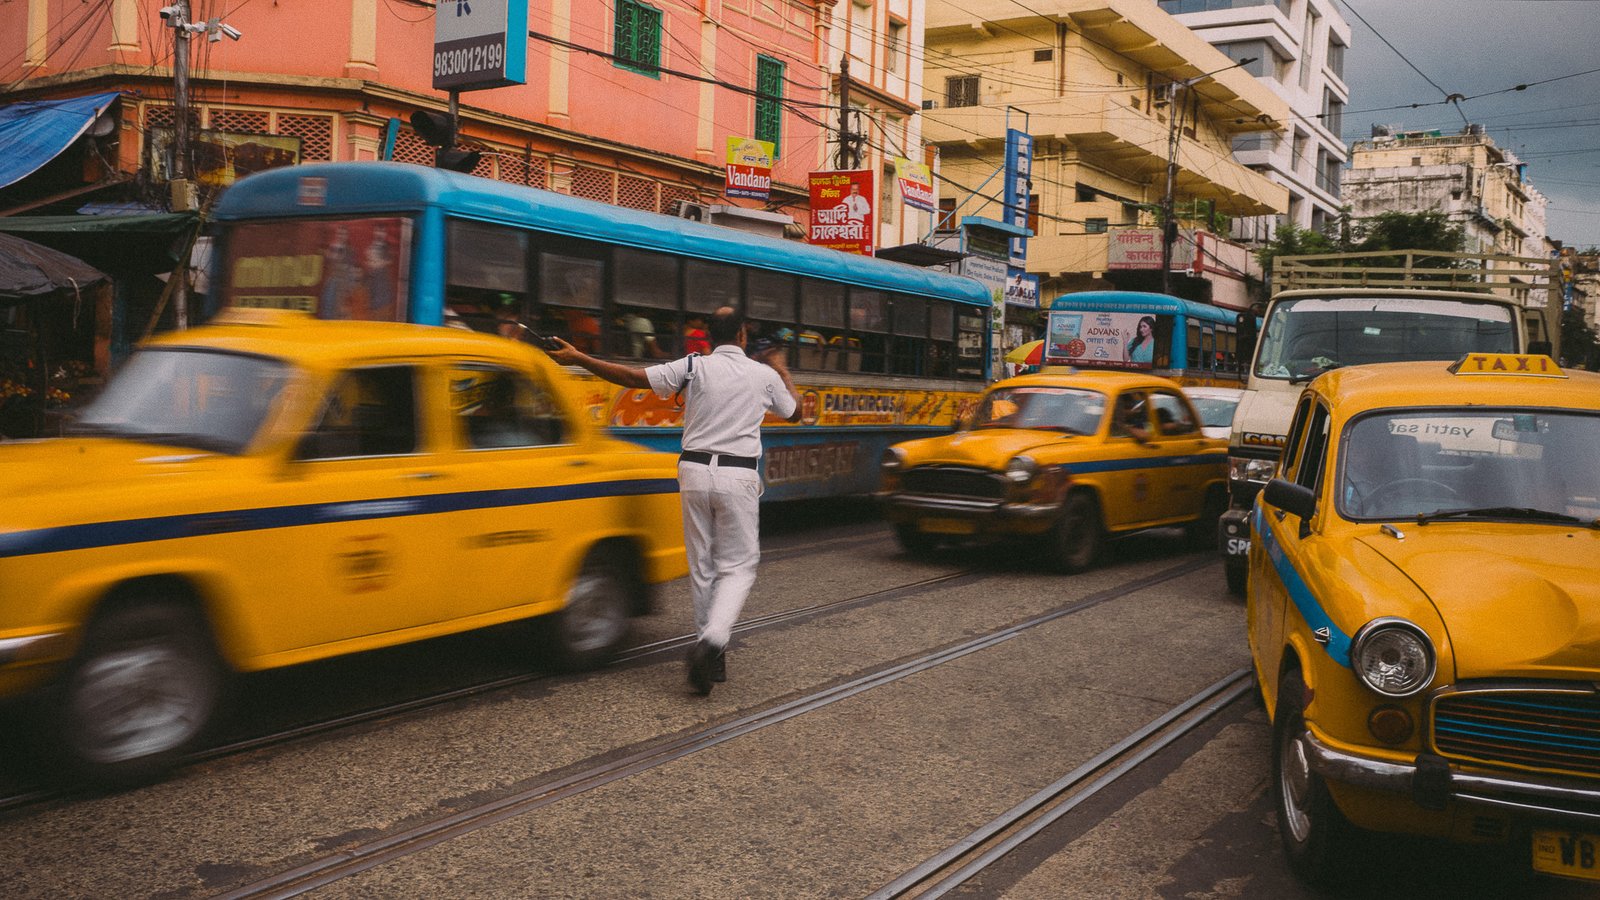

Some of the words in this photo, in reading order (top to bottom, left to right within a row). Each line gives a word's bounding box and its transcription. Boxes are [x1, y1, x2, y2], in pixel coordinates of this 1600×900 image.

[434, 43, 503, 77] 9830012199
[727, 165, 770, 189] Vandana
[899, 179, 933, 203] Vandana
[817, 204, 848, 224] আদি
[1125, 247, 1164, 261] कार्याल
[1087, 328, 1120, 337] ADVANS
[1472, 356, 1548, 372] TAXI
[1558, 837, 1596, 868] WB
